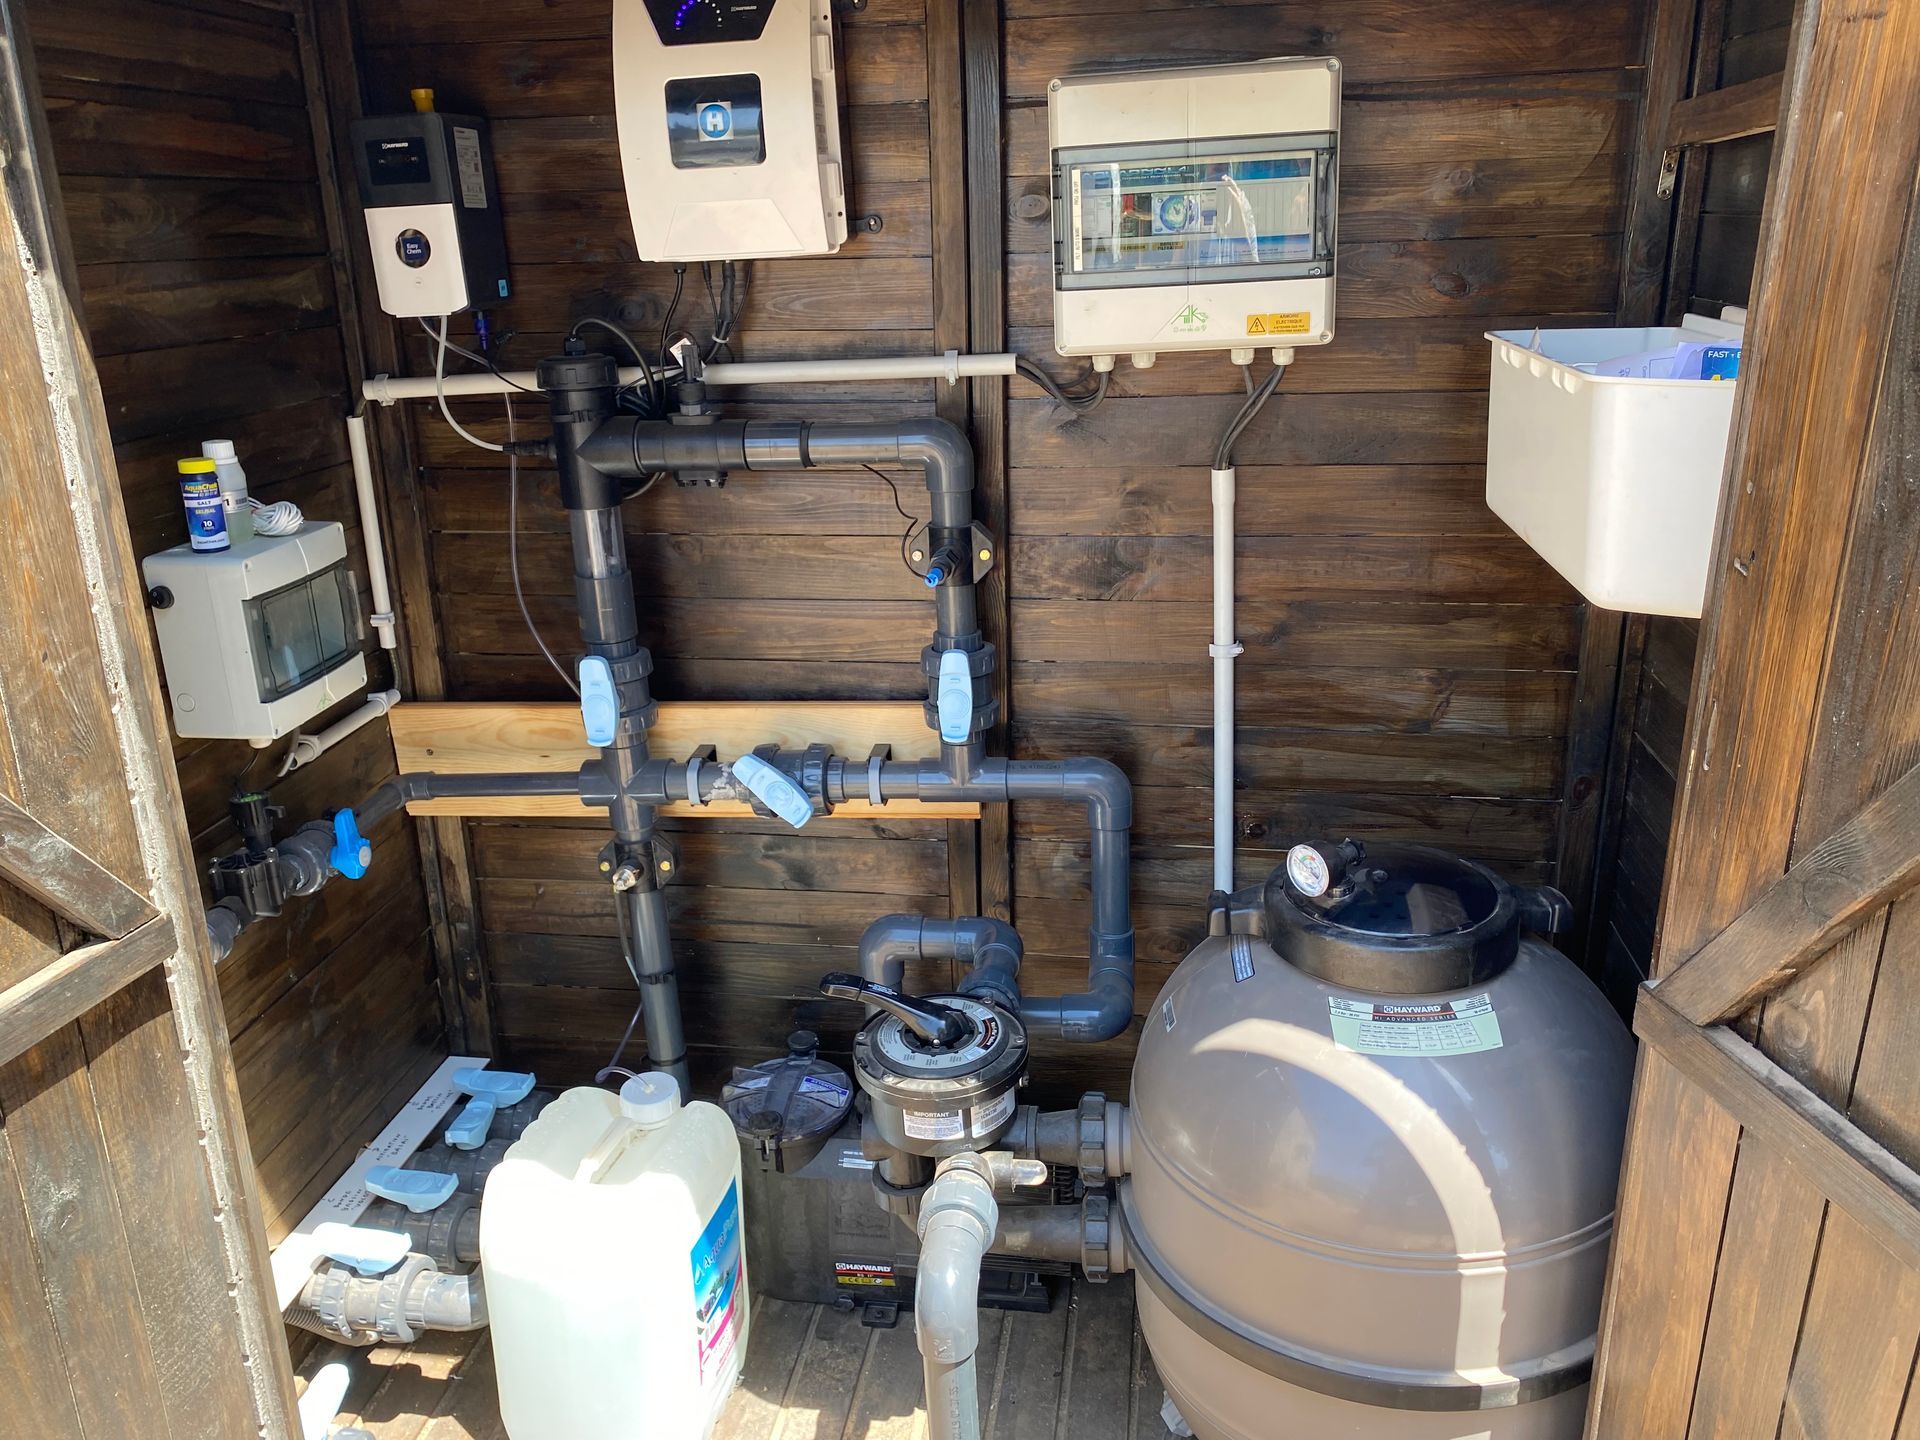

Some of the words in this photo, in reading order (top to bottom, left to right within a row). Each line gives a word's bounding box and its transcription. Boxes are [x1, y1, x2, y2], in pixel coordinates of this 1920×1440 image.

[1707, 350, 1730, 358] FAST
[1394, 1005, 1441, 1014] HAYWARD
[913, 1110, 950, 1118] IMPORTANT
[846, 1263, 892, 1273] HAYWARD
